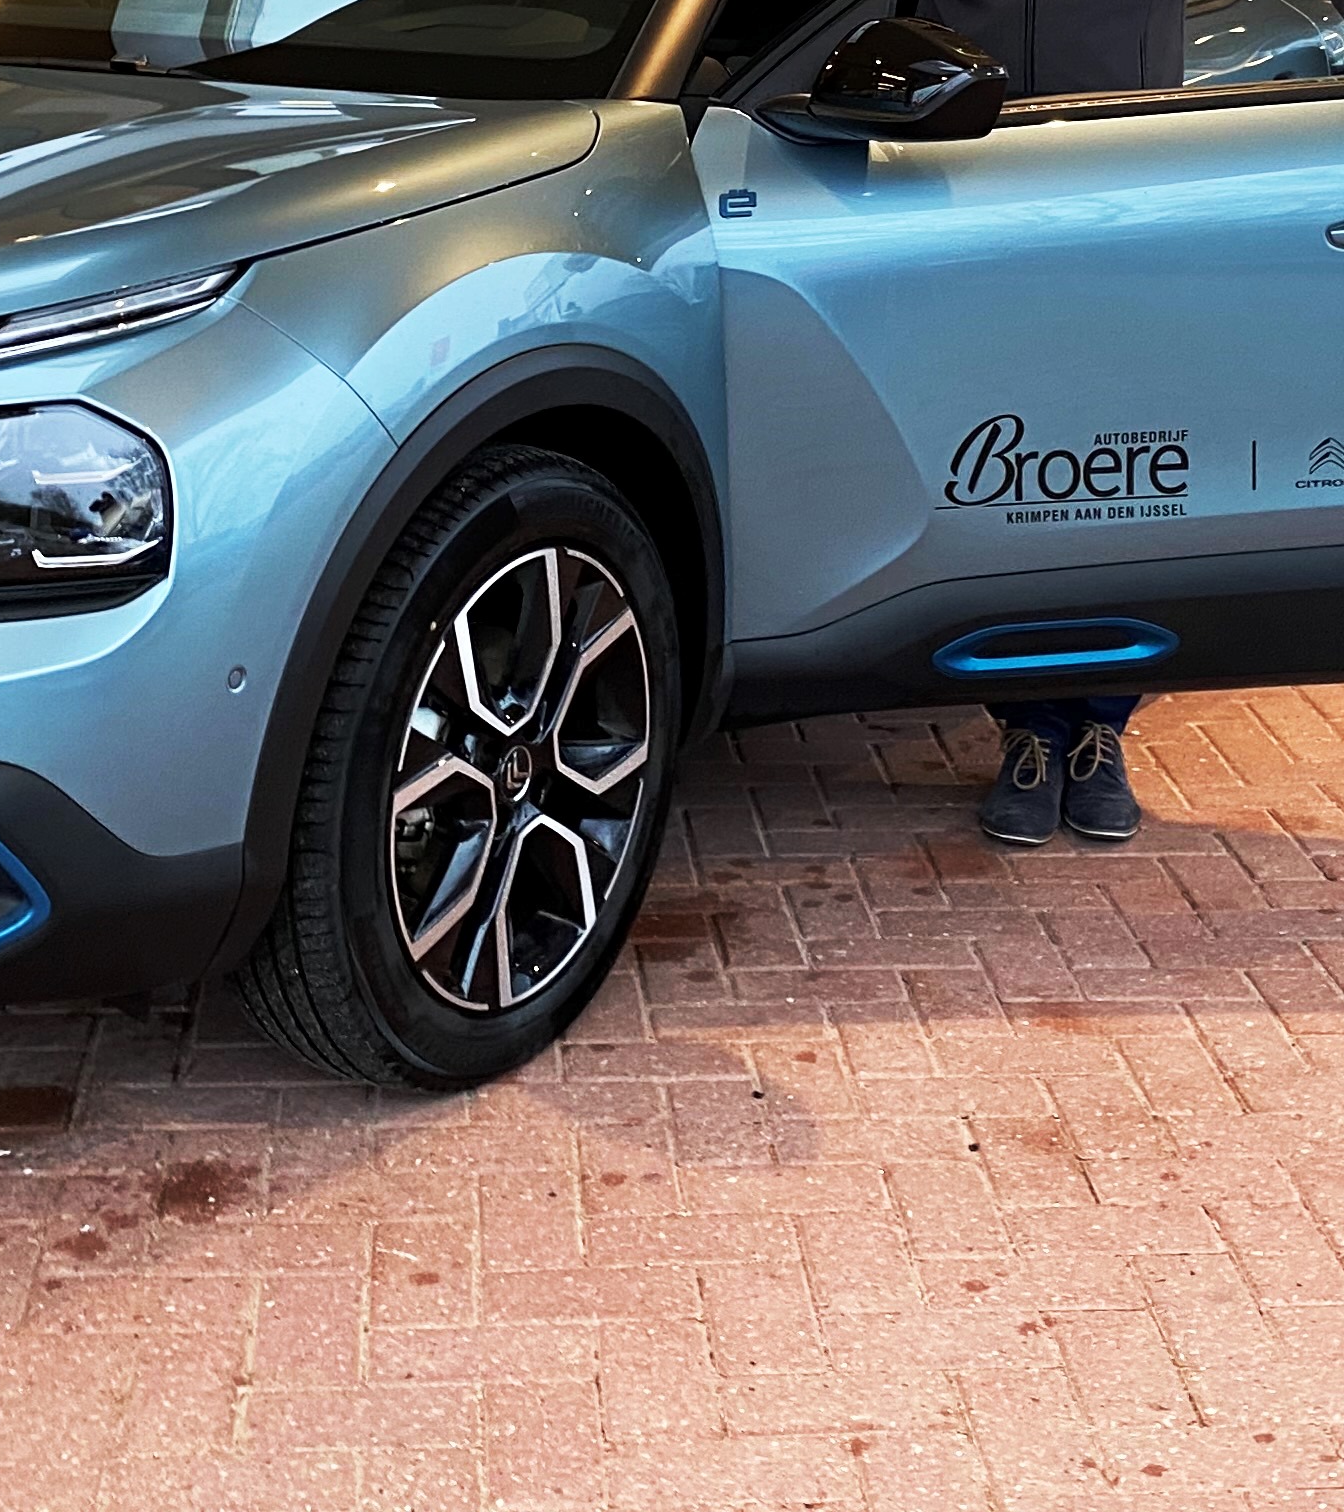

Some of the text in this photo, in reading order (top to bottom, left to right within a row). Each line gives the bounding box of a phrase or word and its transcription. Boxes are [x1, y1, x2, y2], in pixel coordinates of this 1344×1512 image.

[1094, 429, 1189, 446] AUTOBEDRIJF
[944, 414, 1189, 507] Broere
[1006, 503, 1188, 525] KRIMPEN AAN DEN IJSSEL
